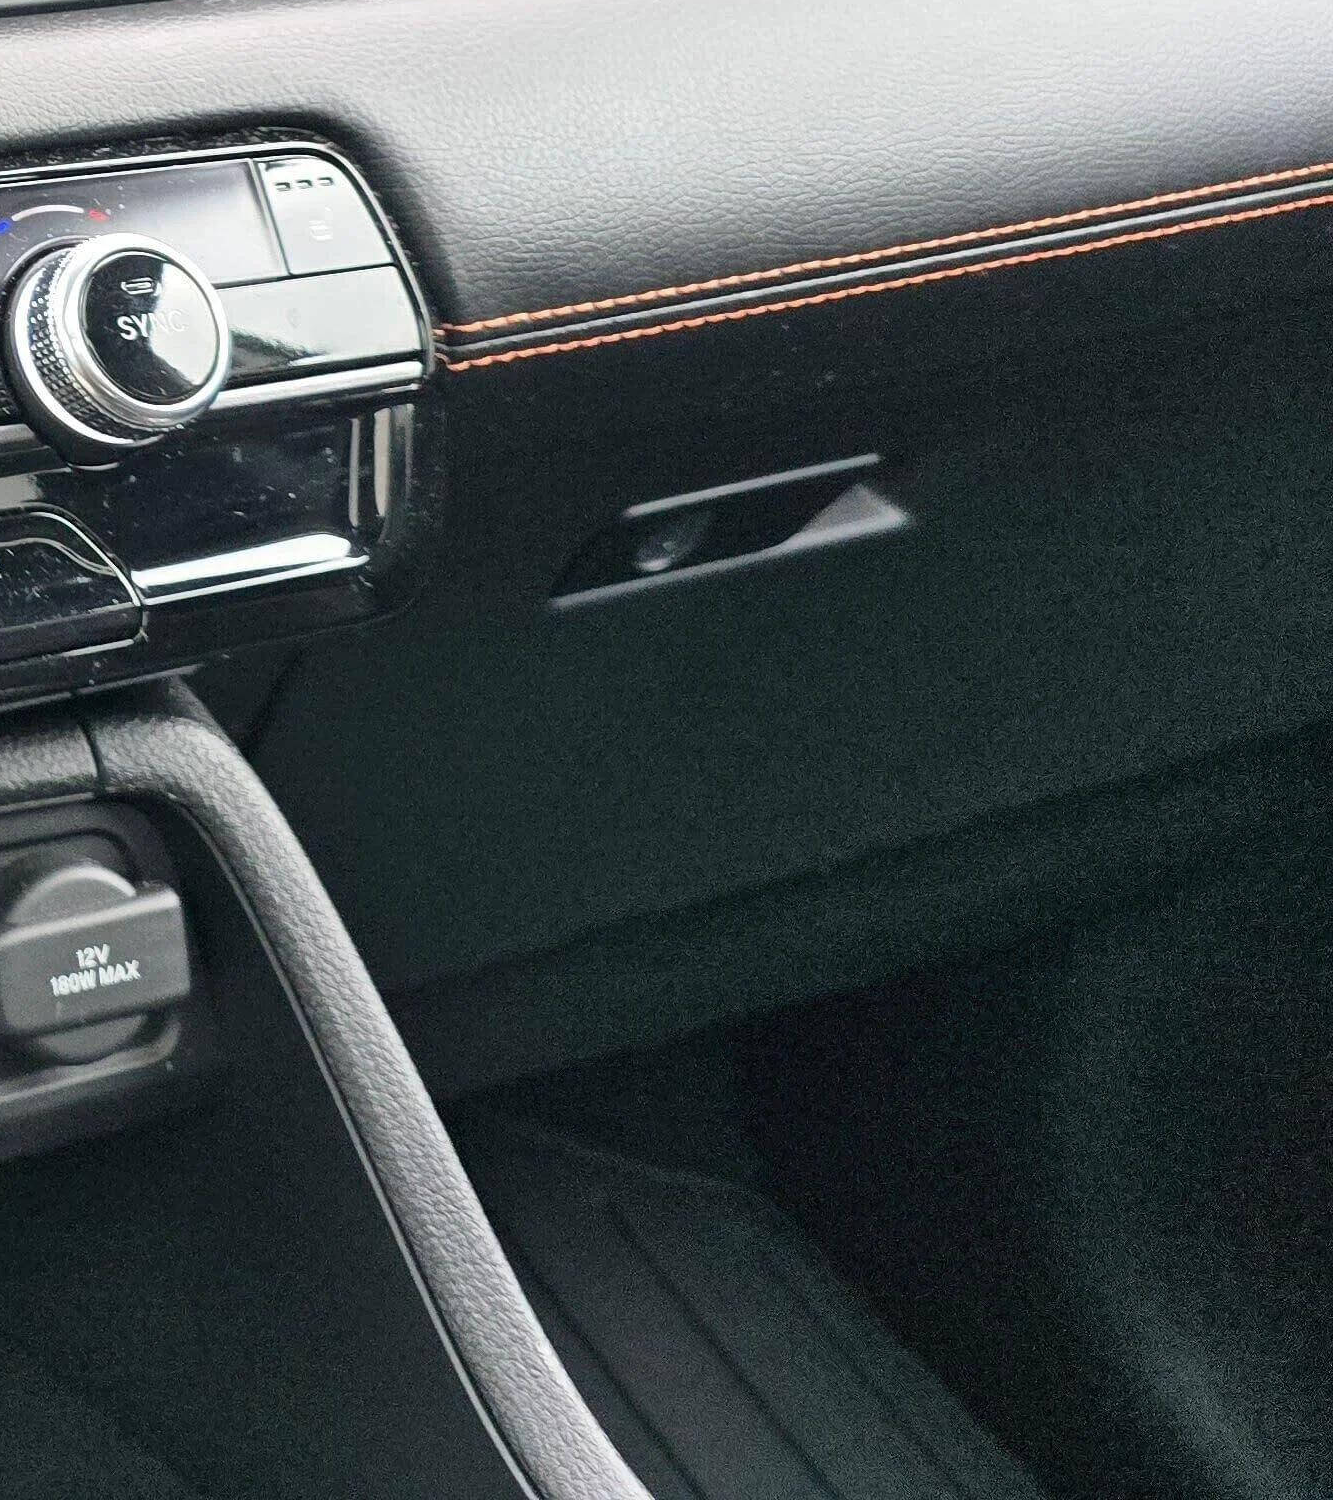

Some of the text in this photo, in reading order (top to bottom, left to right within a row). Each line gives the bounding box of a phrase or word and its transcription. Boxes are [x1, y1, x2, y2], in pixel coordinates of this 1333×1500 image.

[116, 309, 186, 341] SYNC
[75, 943, 111, 970] 12V
[98, 959, 141, 988] MAX
